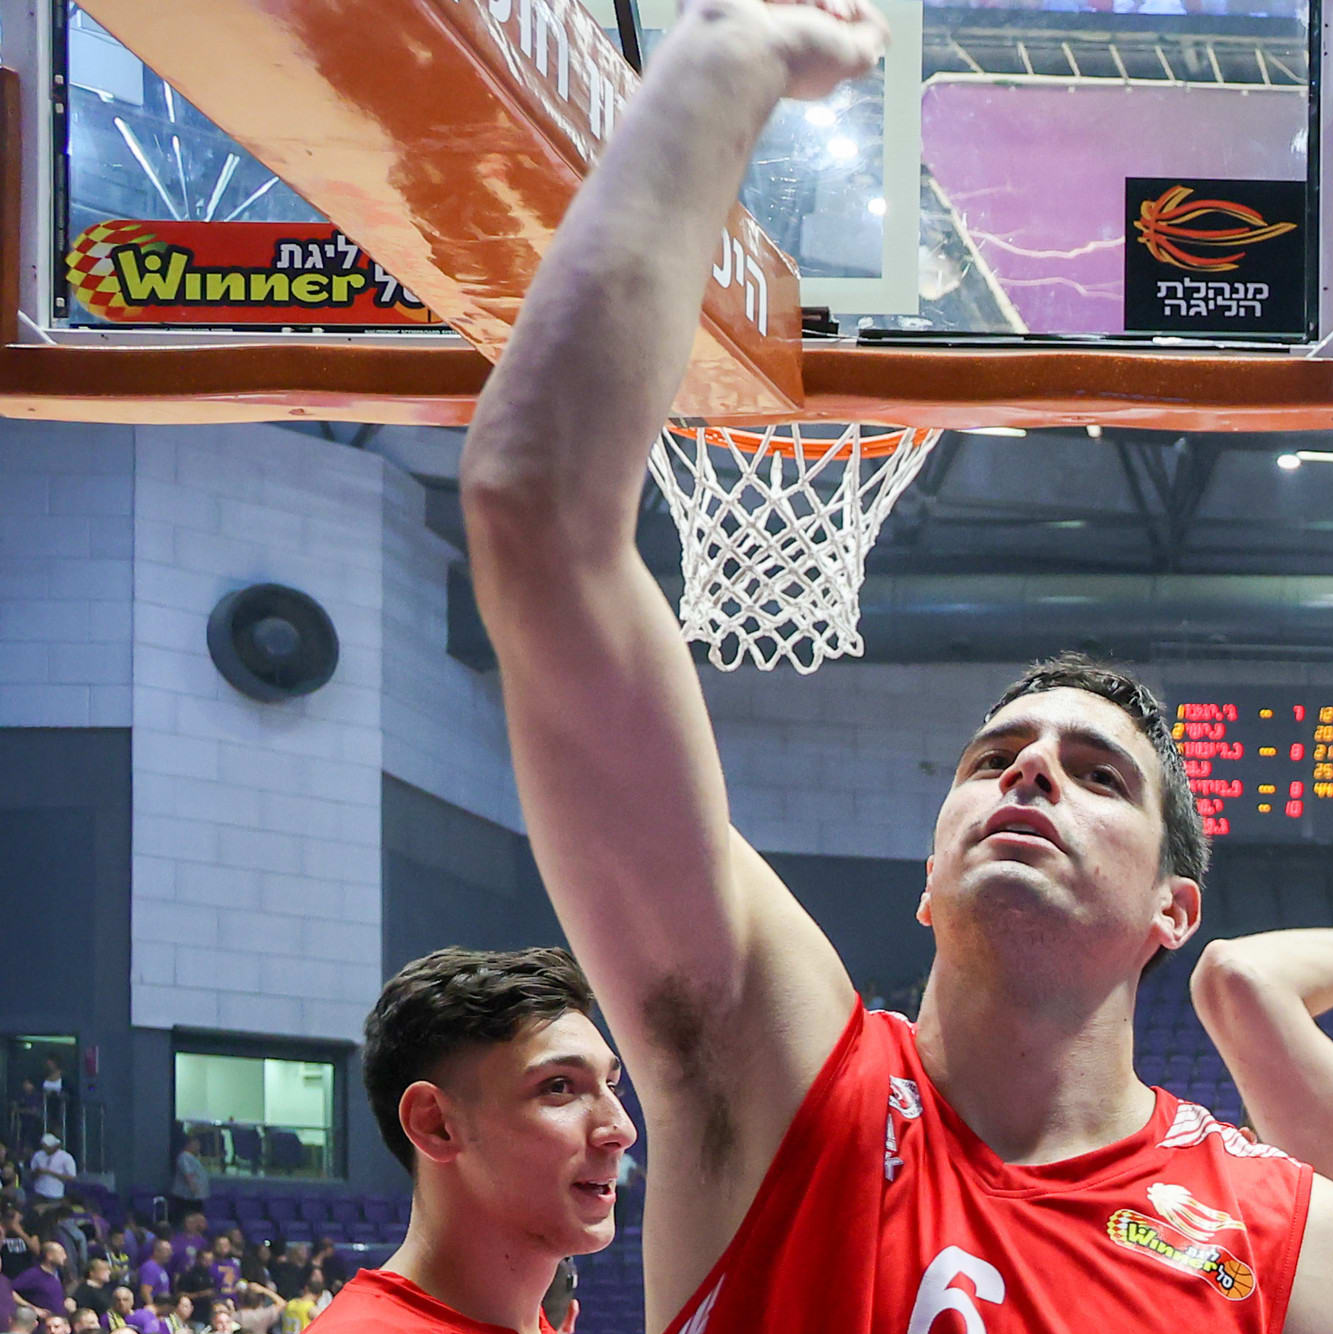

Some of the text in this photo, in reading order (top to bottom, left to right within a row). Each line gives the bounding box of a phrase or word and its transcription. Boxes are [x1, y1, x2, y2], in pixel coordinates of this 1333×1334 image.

[277, 235, 359, 269] ליגת
[117, 249, 364, 301] Winner
[1157, 277, 1269, 300] מנהלת
[1164, 296, 1261, 317] הליגה
[1126, 1222, 1218, 1274] Winner
[1215, 1264, 1235, 1290] סל
